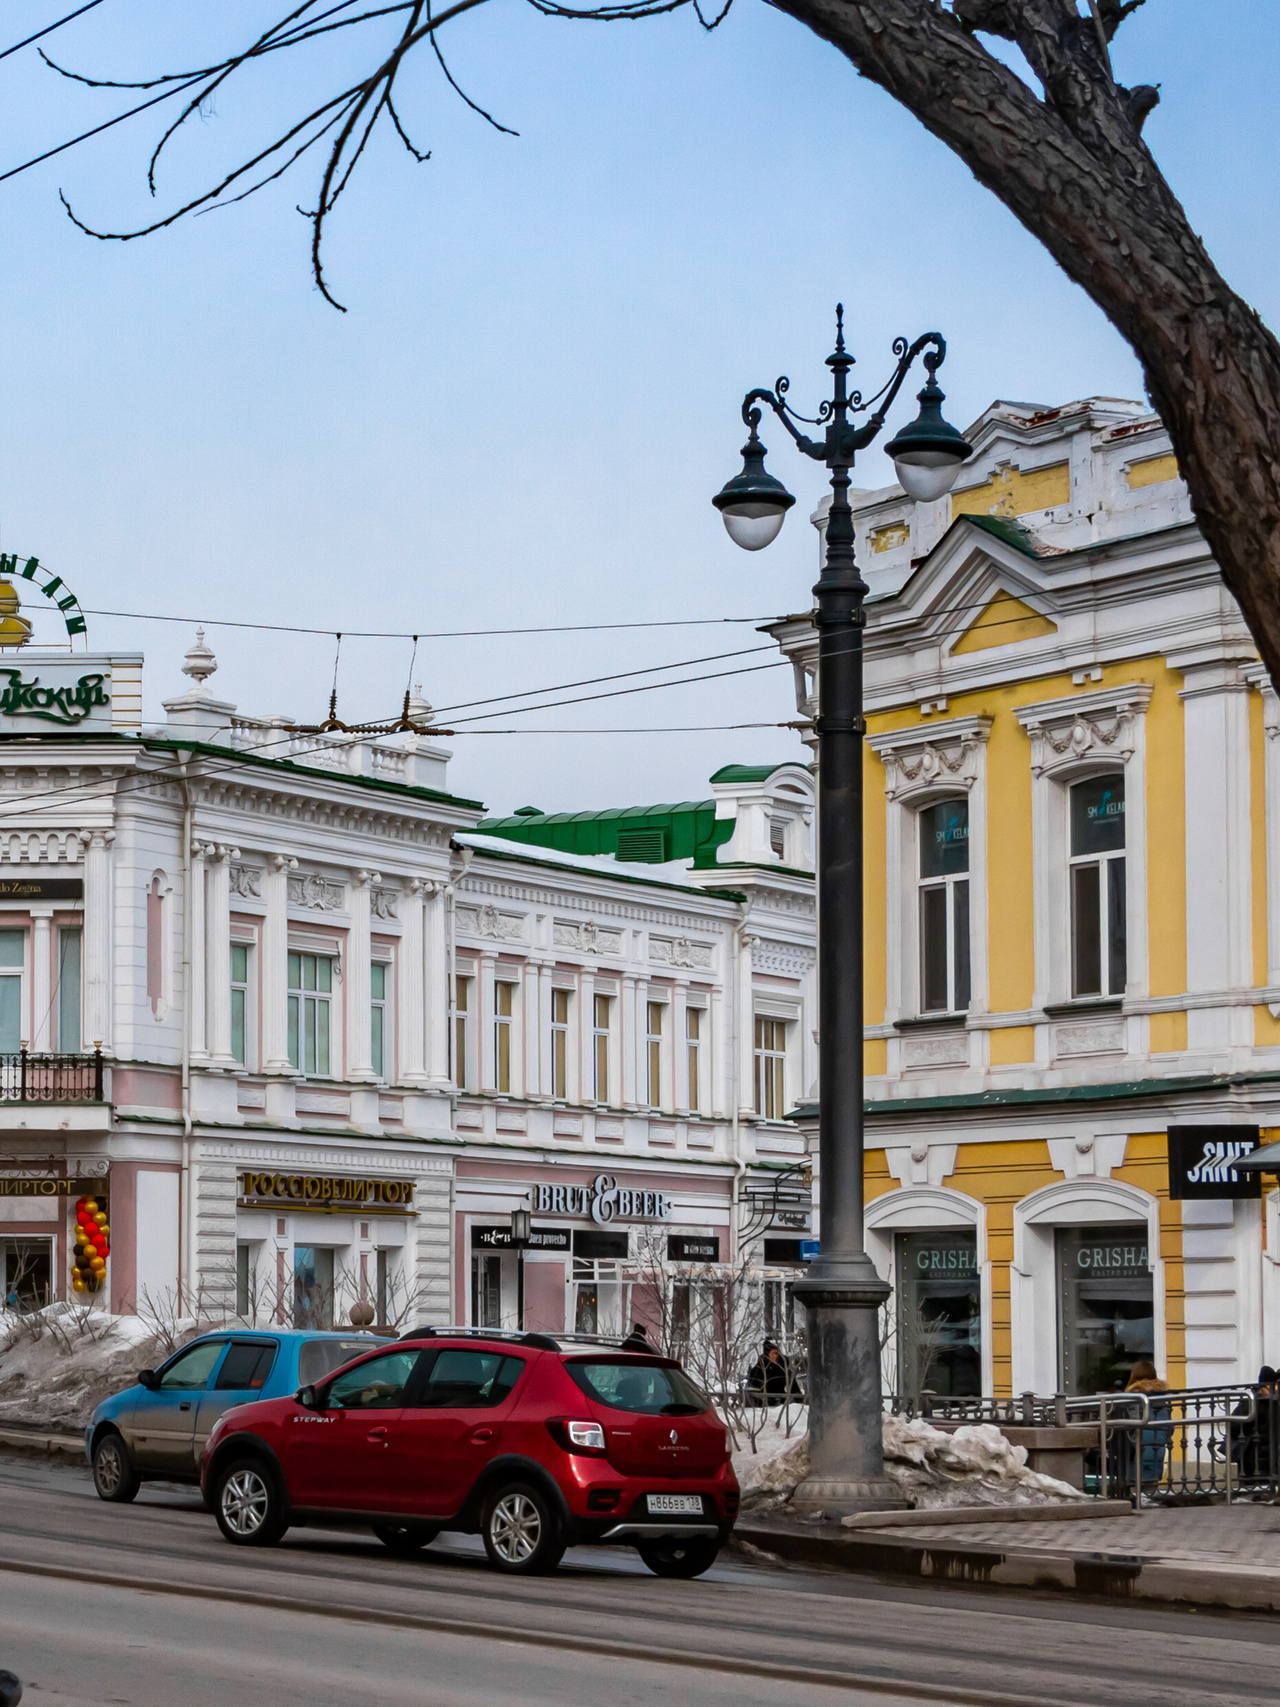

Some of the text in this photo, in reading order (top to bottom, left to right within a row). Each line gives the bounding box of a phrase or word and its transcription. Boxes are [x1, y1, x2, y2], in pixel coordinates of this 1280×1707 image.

[41, 576, 87, 636] ДОМ
[11, 883, 41, 895] Zegna
[243, 1172, 415, 1203] РОССЮВЕЛИРТОРГ
[536, 1184, 590, 1213] BRUT
[618, 1190, 668, 1218] BEER
[1077, 1247, 1148, 1268] GRISHA
